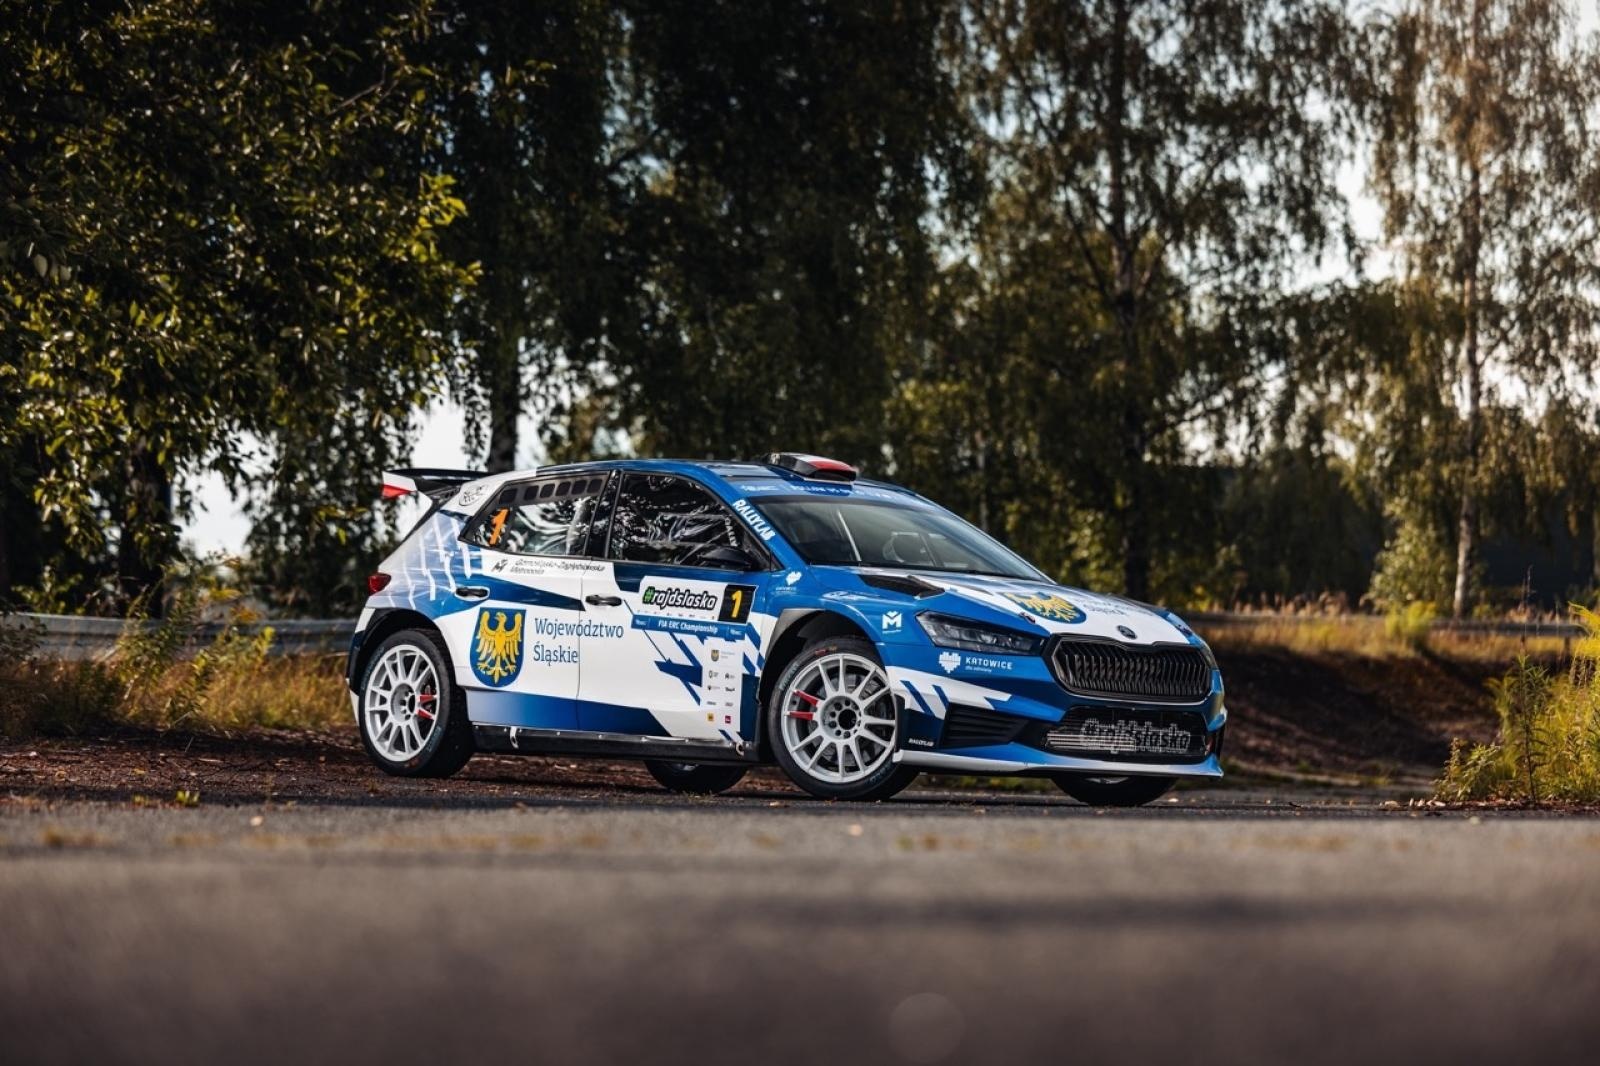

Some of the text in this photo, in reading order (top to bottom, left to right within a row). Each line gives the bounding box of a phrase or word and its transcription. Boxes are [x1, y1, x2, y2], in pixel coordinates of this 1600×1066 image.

[489, 508, 509, 545] 1
[732, 499, 776, 541] RALLYLAB
[642, 585, 717, 610] #rajdslaska
[731, 590, 742, 618] 1
[534, 617, 624, 639] Województwo
[658, 620, 668, 628] FIA
[680, 622, 718, 634] Championship
[533, 641, 579, 666] Śląskie
[965, 656, 1013, 670] KATOWICE
